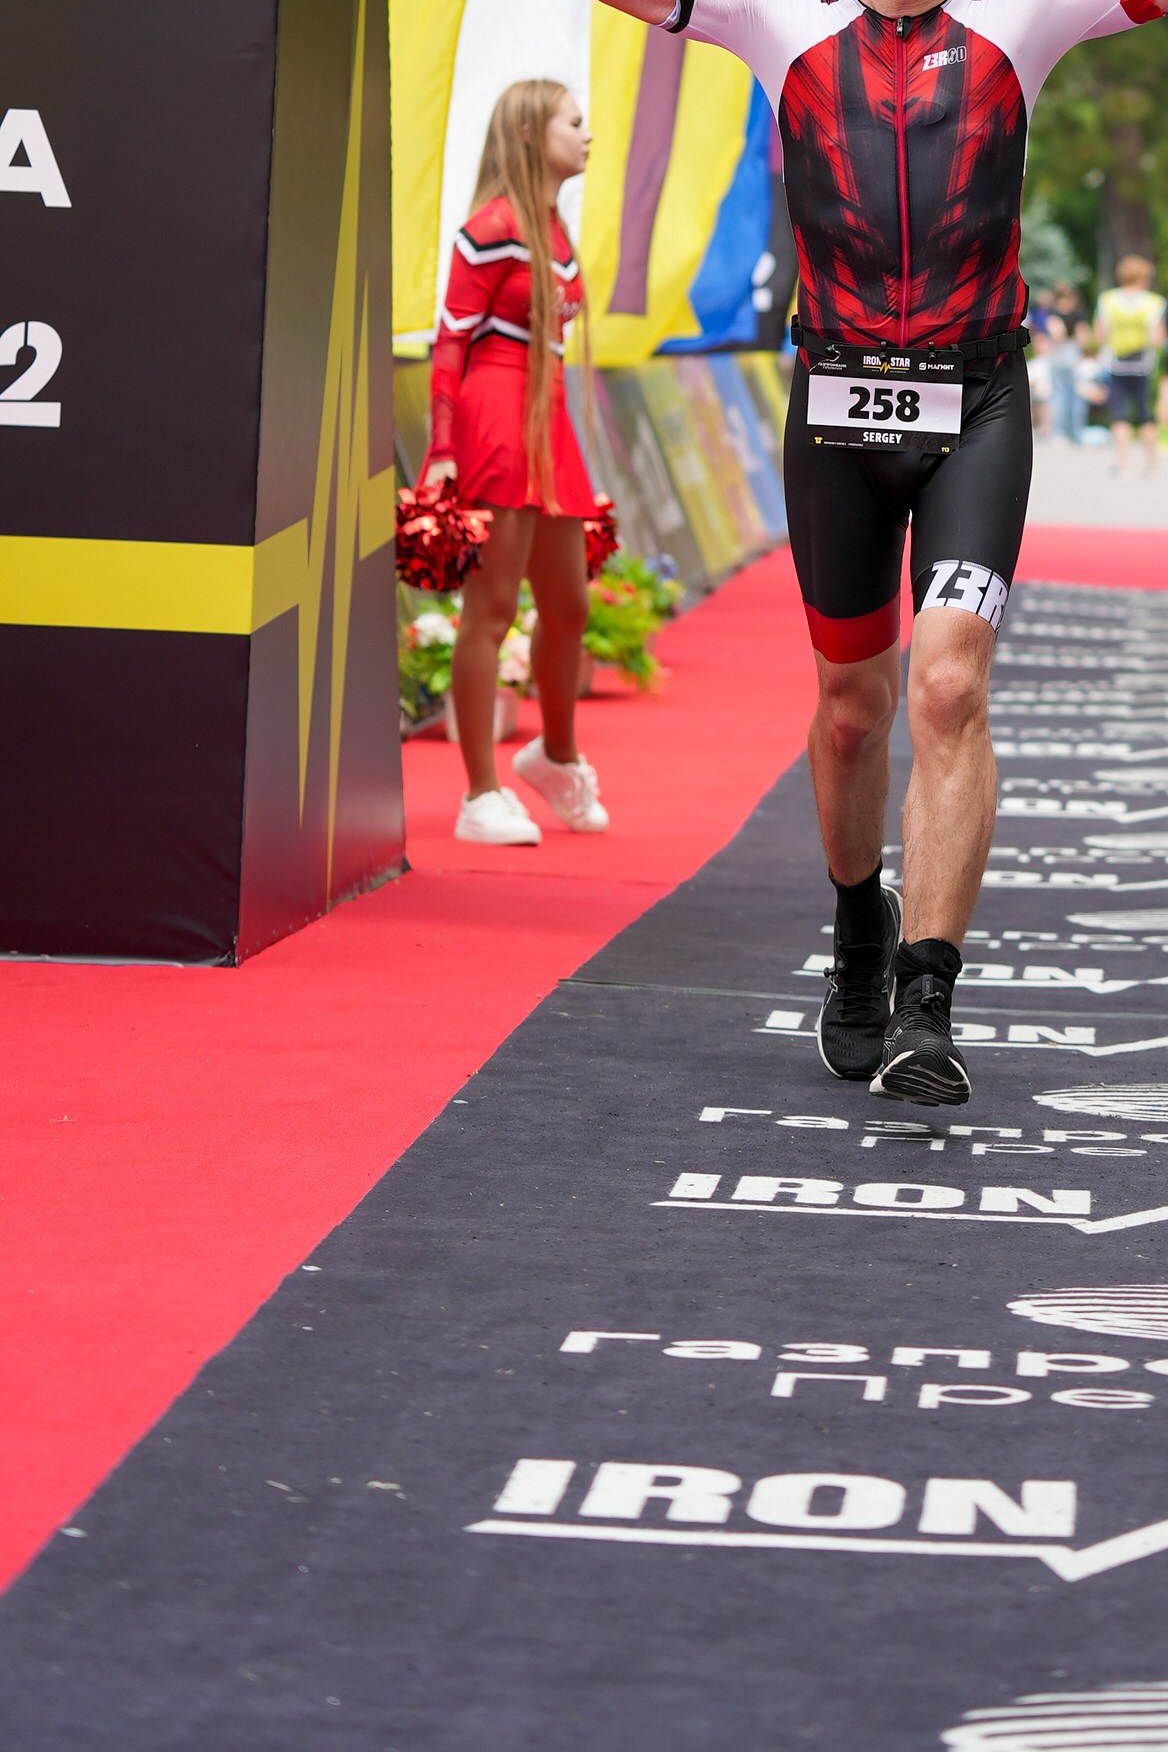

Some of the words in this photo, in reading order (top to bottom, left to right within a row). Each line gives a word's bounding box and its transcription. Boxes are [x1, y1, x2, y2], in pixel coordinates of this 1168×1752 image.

[890, 356, 911, 368] STAR
[847, 386, 921, 423] 258
[862, 431, 903, 444] SERGEY
[765, 1009, 1097, 1045] ION
[668, 1172, 1092, 1216] IRON
[492, 1458, 1077, 1538] IRON
